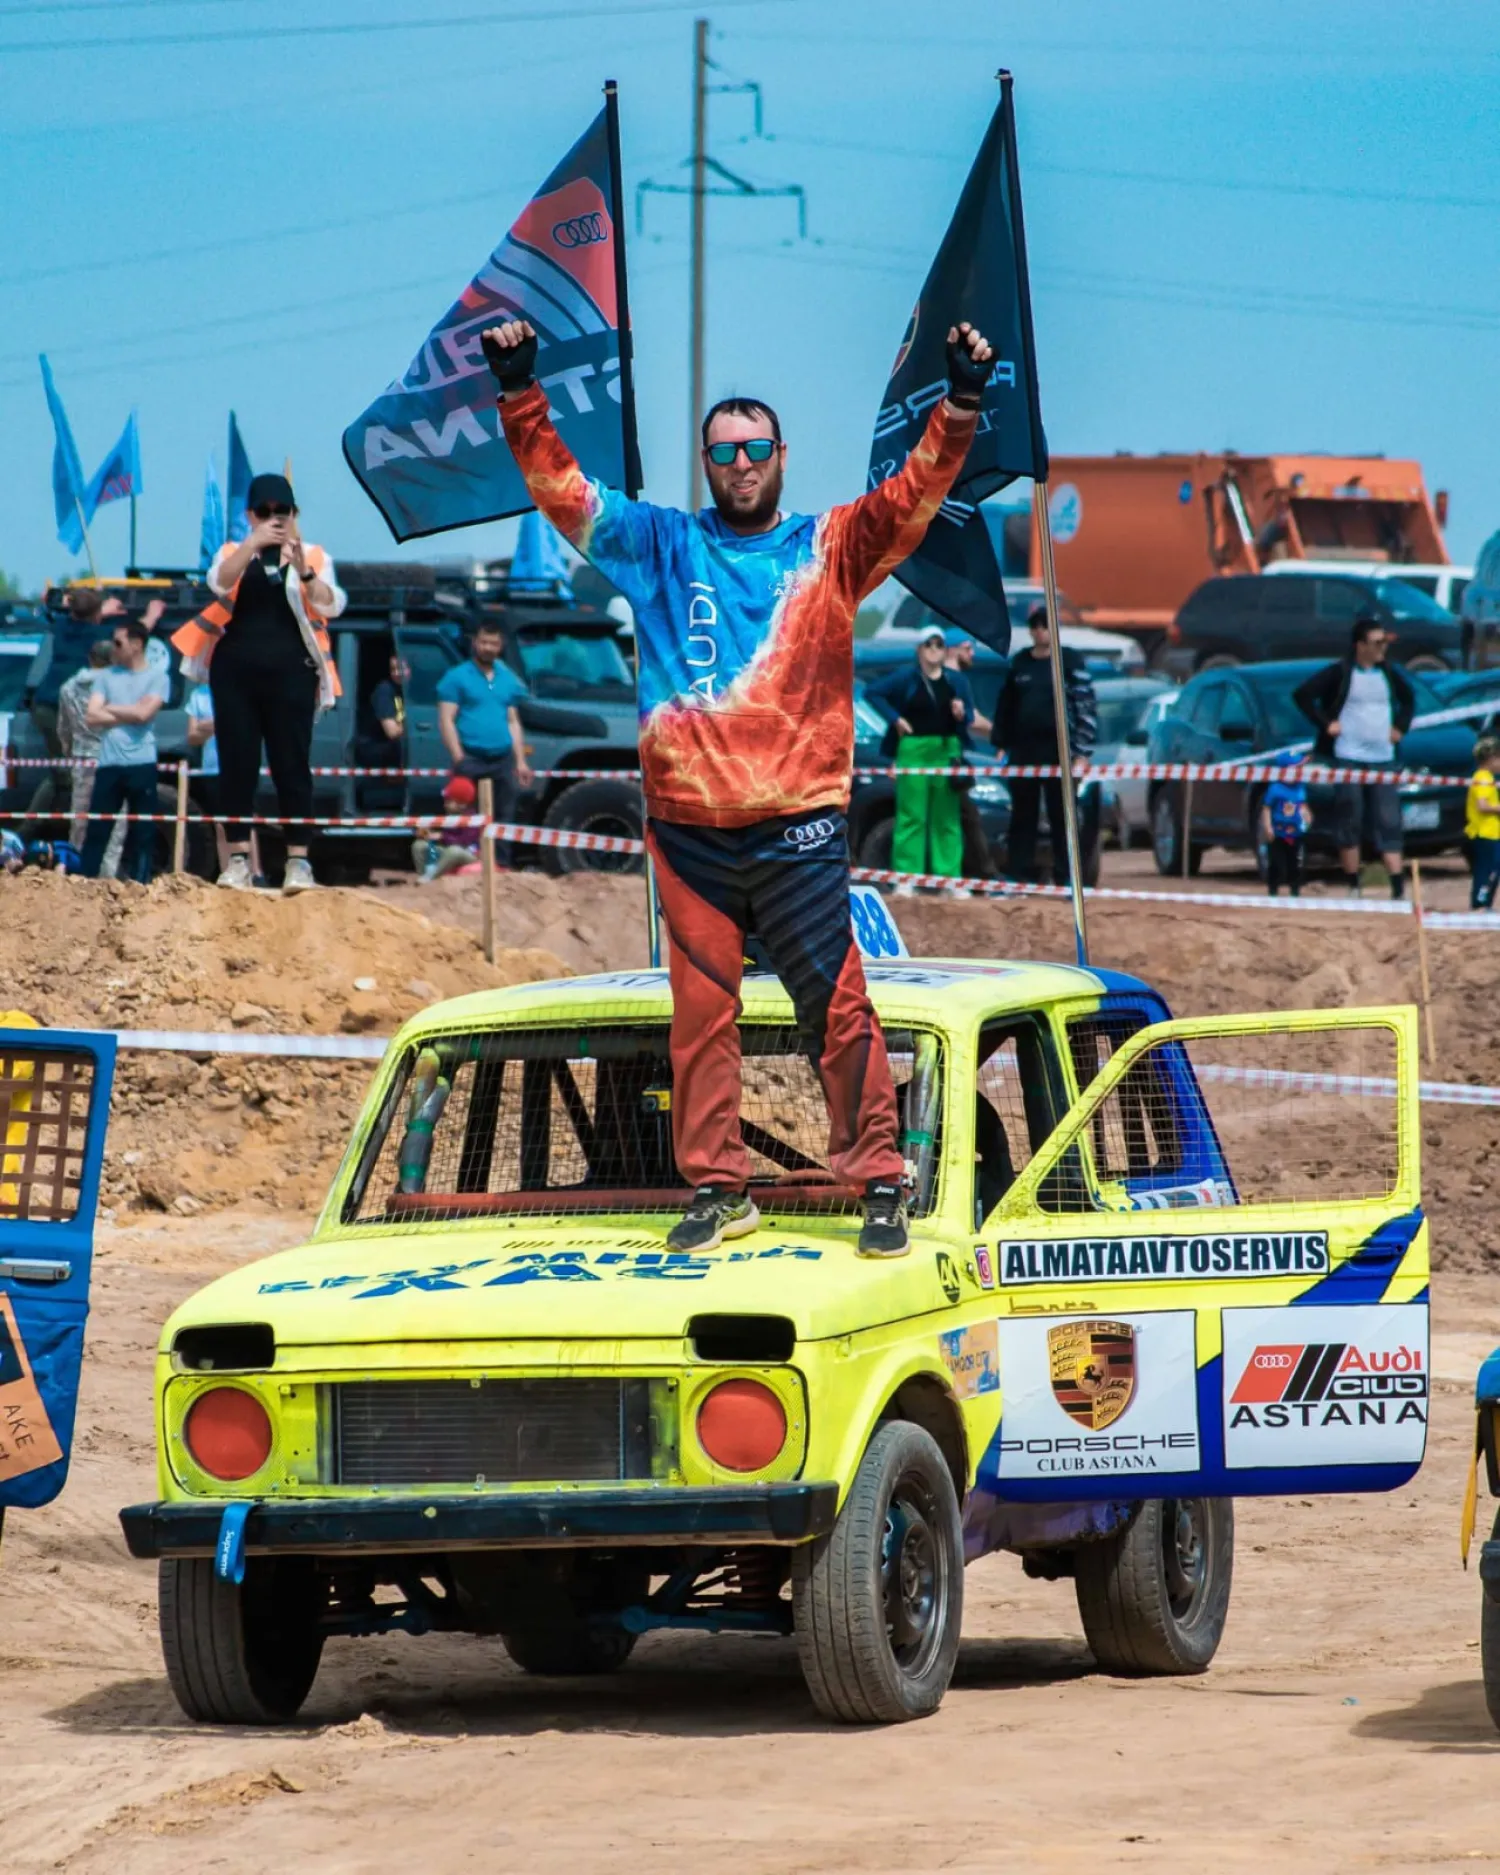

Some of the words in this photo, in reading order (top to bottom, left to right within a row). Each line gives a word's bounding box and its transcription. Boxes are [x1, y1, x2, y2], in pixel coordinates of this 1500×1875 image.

[686, 582, 717, 704] AUDI
[1005, 1236, 1326, 1278] ALMATAAVTOSERVIS
[1338, 1346, 1422, 1373] Audi
[1229, 1401, 1427, 1428] ASTANA
[1000, 1433, 1196, 1454] PORSCHE
[1037, 1458, 1085, 1472] CLUB
[1089, 1454, 1157, 1469] ASTANA
